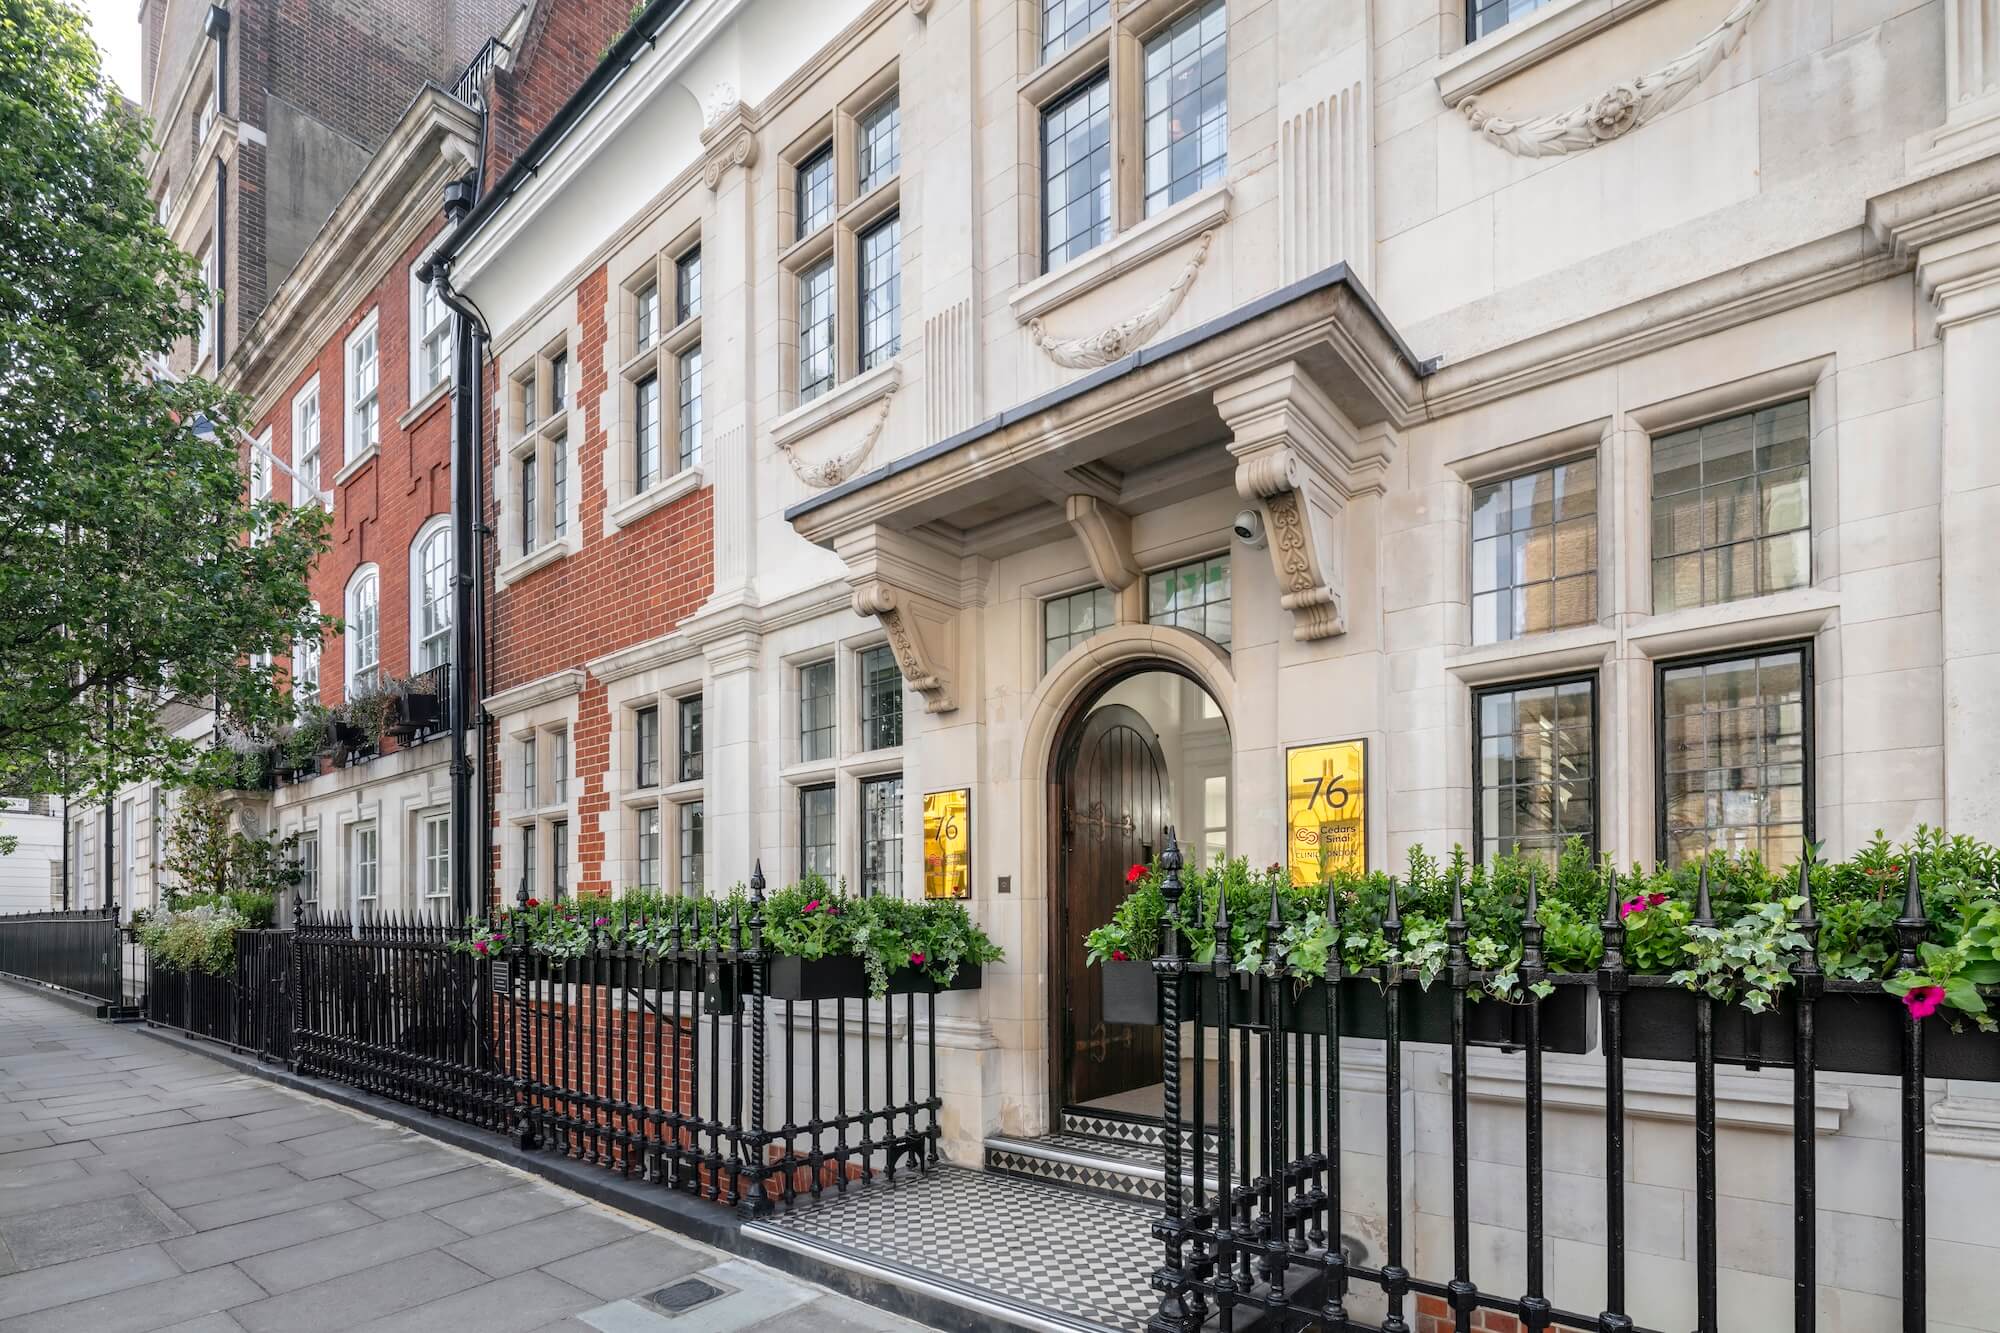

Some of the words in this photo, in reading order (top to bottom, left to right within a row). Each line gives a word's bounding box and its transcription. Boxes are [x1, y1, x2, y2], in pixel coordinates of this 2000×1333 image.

[1303, 774, 1349, 810] 76
[932, 815, 958, 841] 76
[1320, 825, 1356, 834] Cedars
[1326, 833, 1350, 843] Sinai
[1295, 851, 1320, 859] CLINI
[1325, 848, 1357, 857] ONDON
